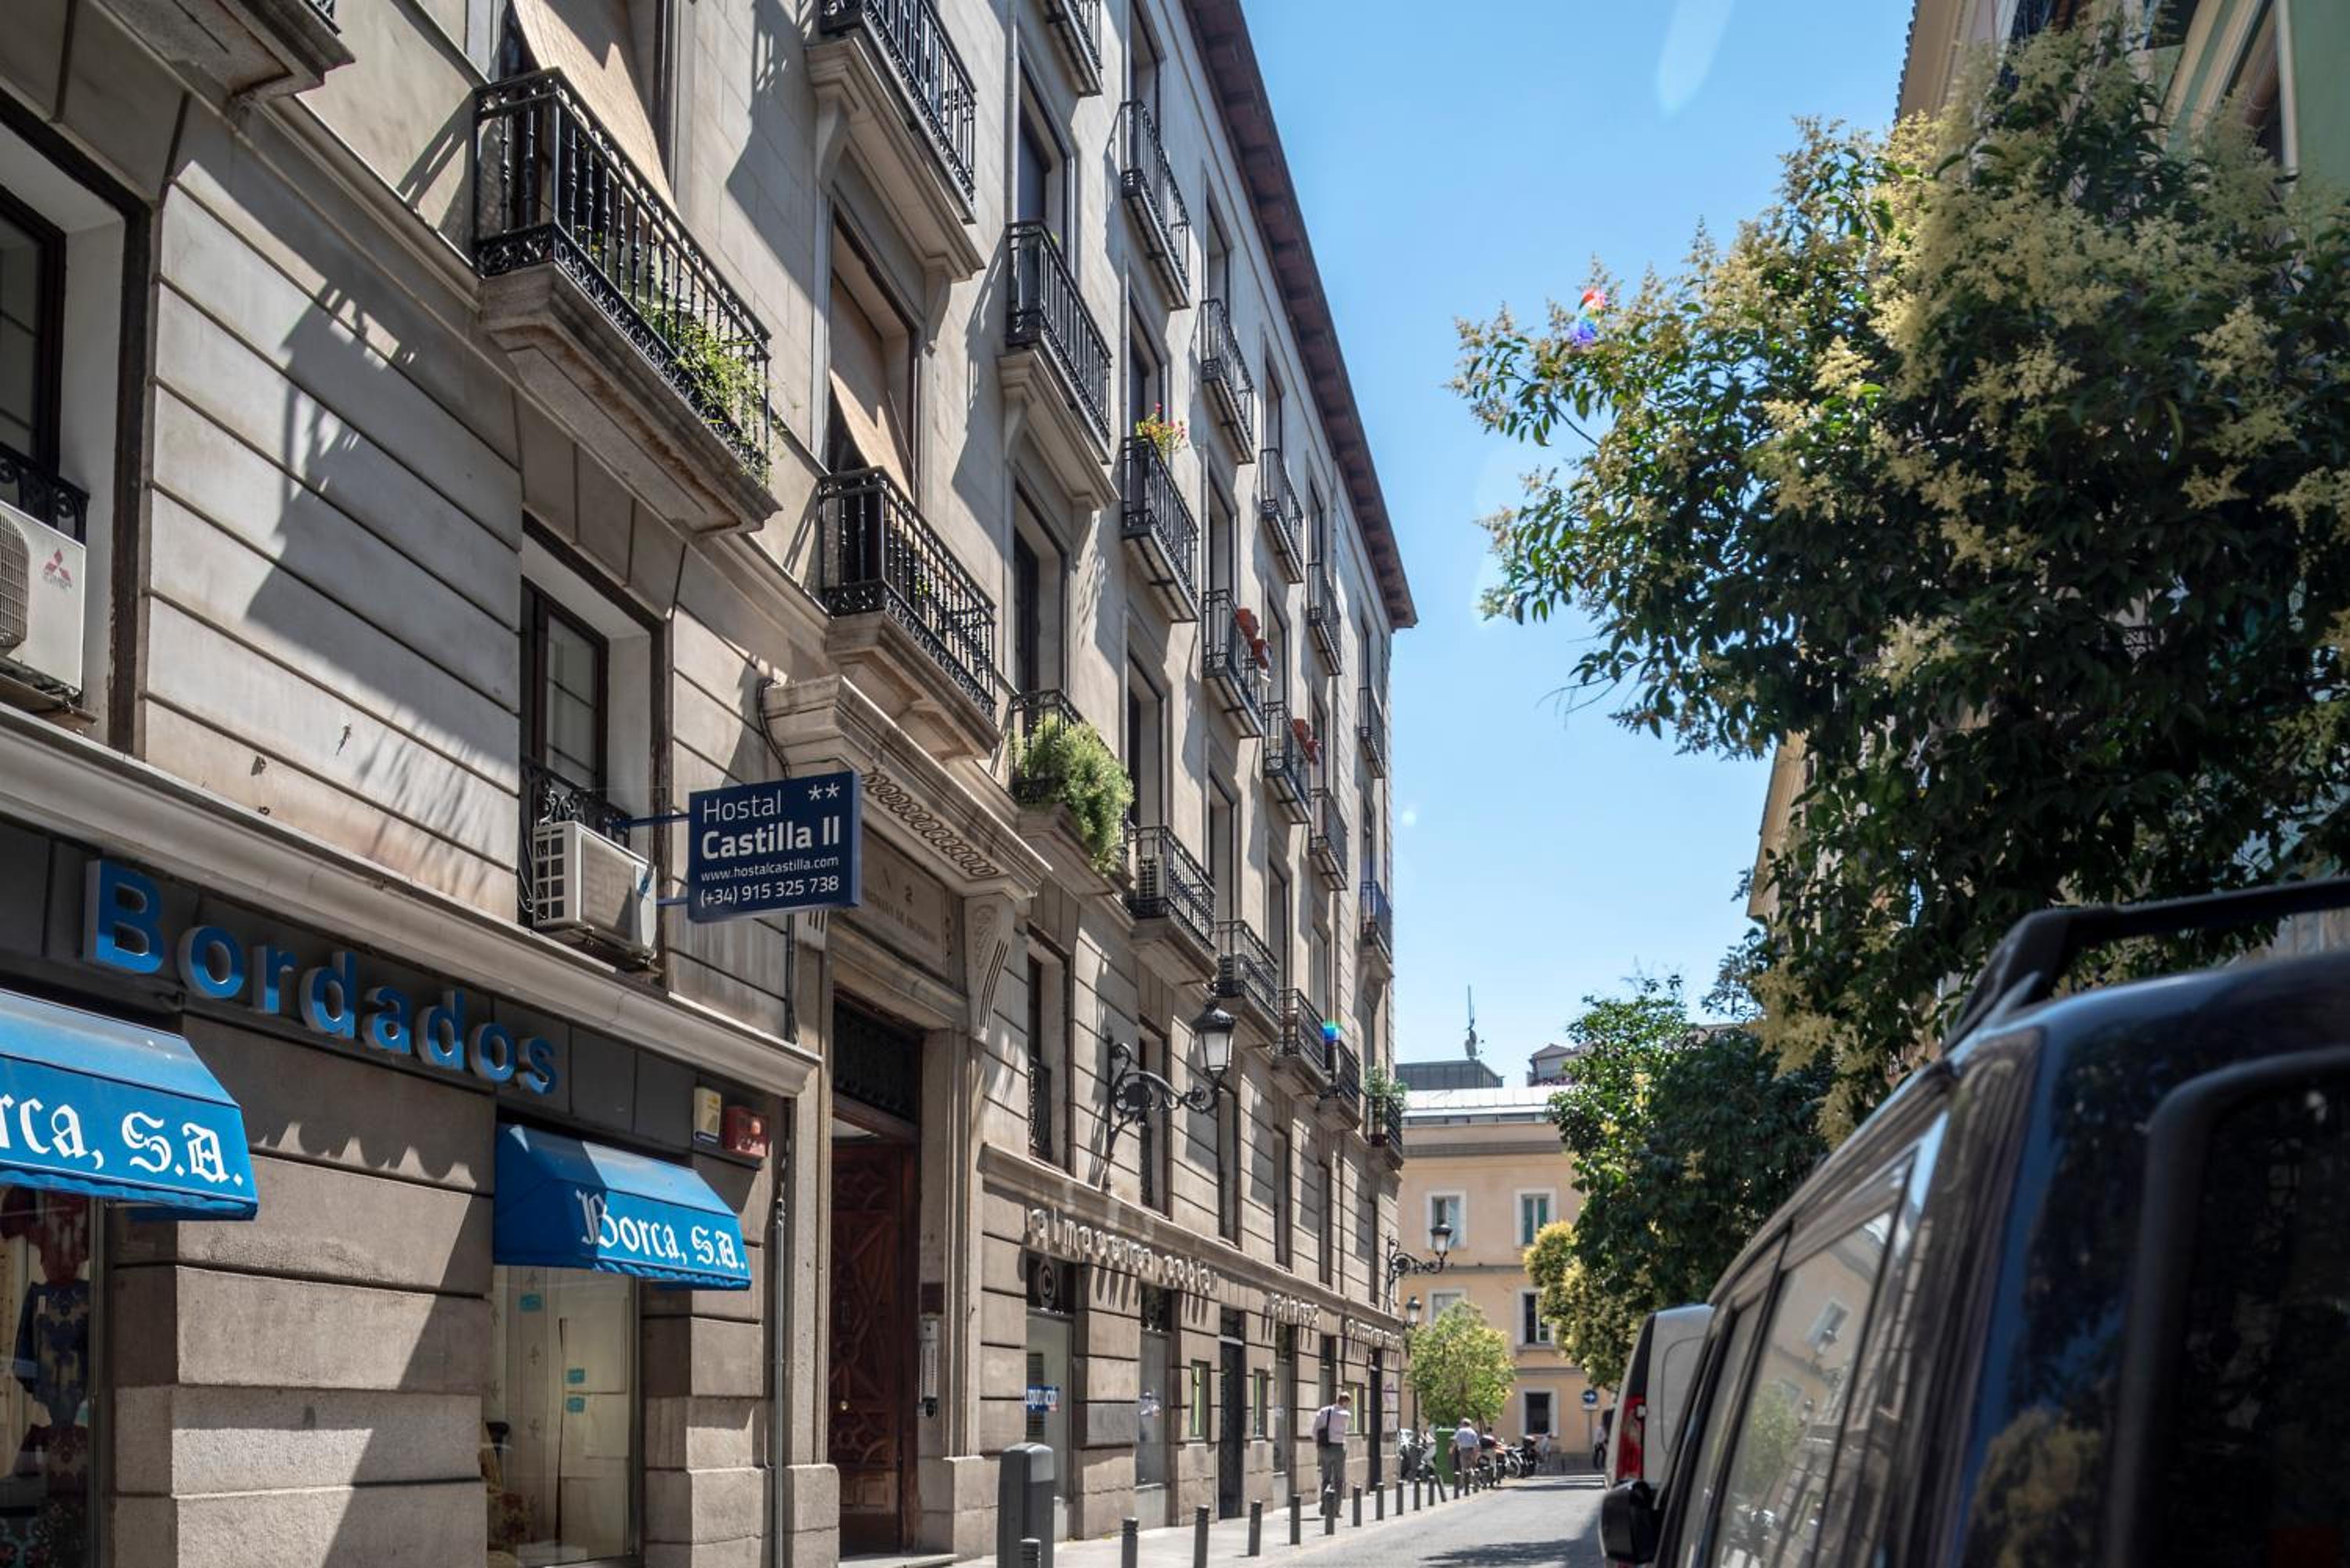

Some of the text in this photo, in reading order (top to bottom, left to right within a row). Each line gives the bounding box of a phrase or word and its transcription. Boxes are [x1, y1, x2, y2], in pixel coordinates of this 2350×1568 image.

[703, 789, 781, 823] Hostal
[702, 816, 840, 859] Castilla II
[701, 856, 840, 882] www.hostalcastilla.com
[700, 875, 840, 908] (+34) 915 325 738
[84, 859, 558, 1095] Bordados
[121, 1111, 244, 1187] S.A.
[576, 1189, 744, 1270] Borca, S.A.
